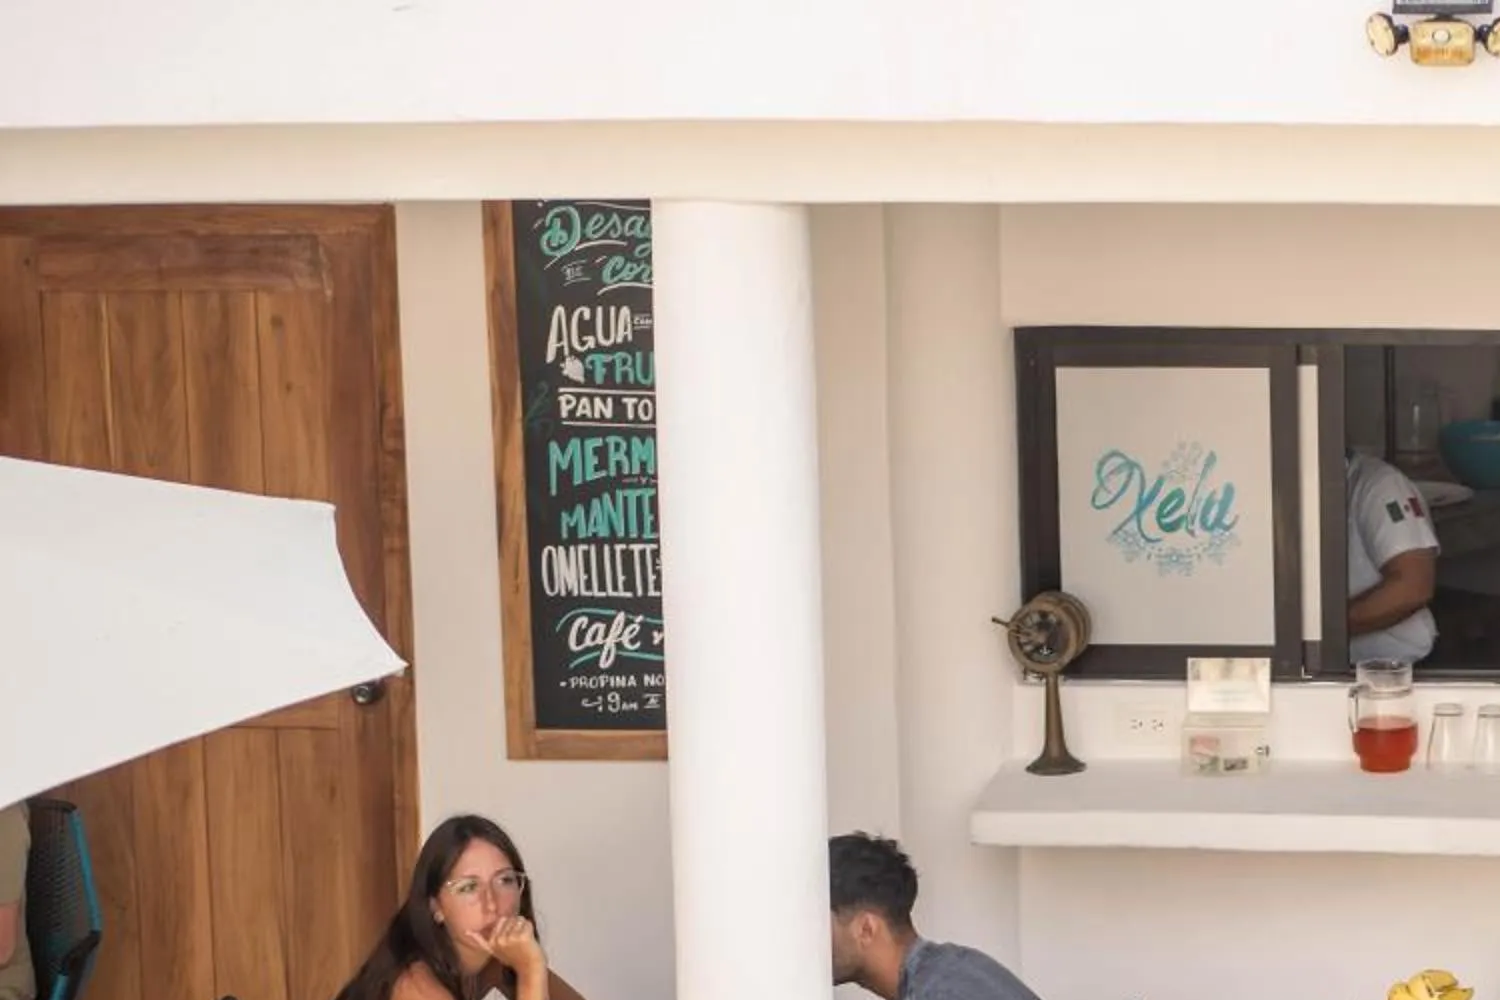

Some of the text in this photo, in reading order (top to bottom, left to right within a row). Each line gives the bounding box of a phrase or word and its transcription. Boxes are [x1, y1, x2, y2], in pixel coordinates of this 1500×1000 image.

[541, 205, 651, 257] Desa
[546, 305, 633, 363] AGUA
[558, 393, 653, 421] PAN TO
[568, 611, 643, 668] Café
[569, 674, 637, 689] PROPINA
